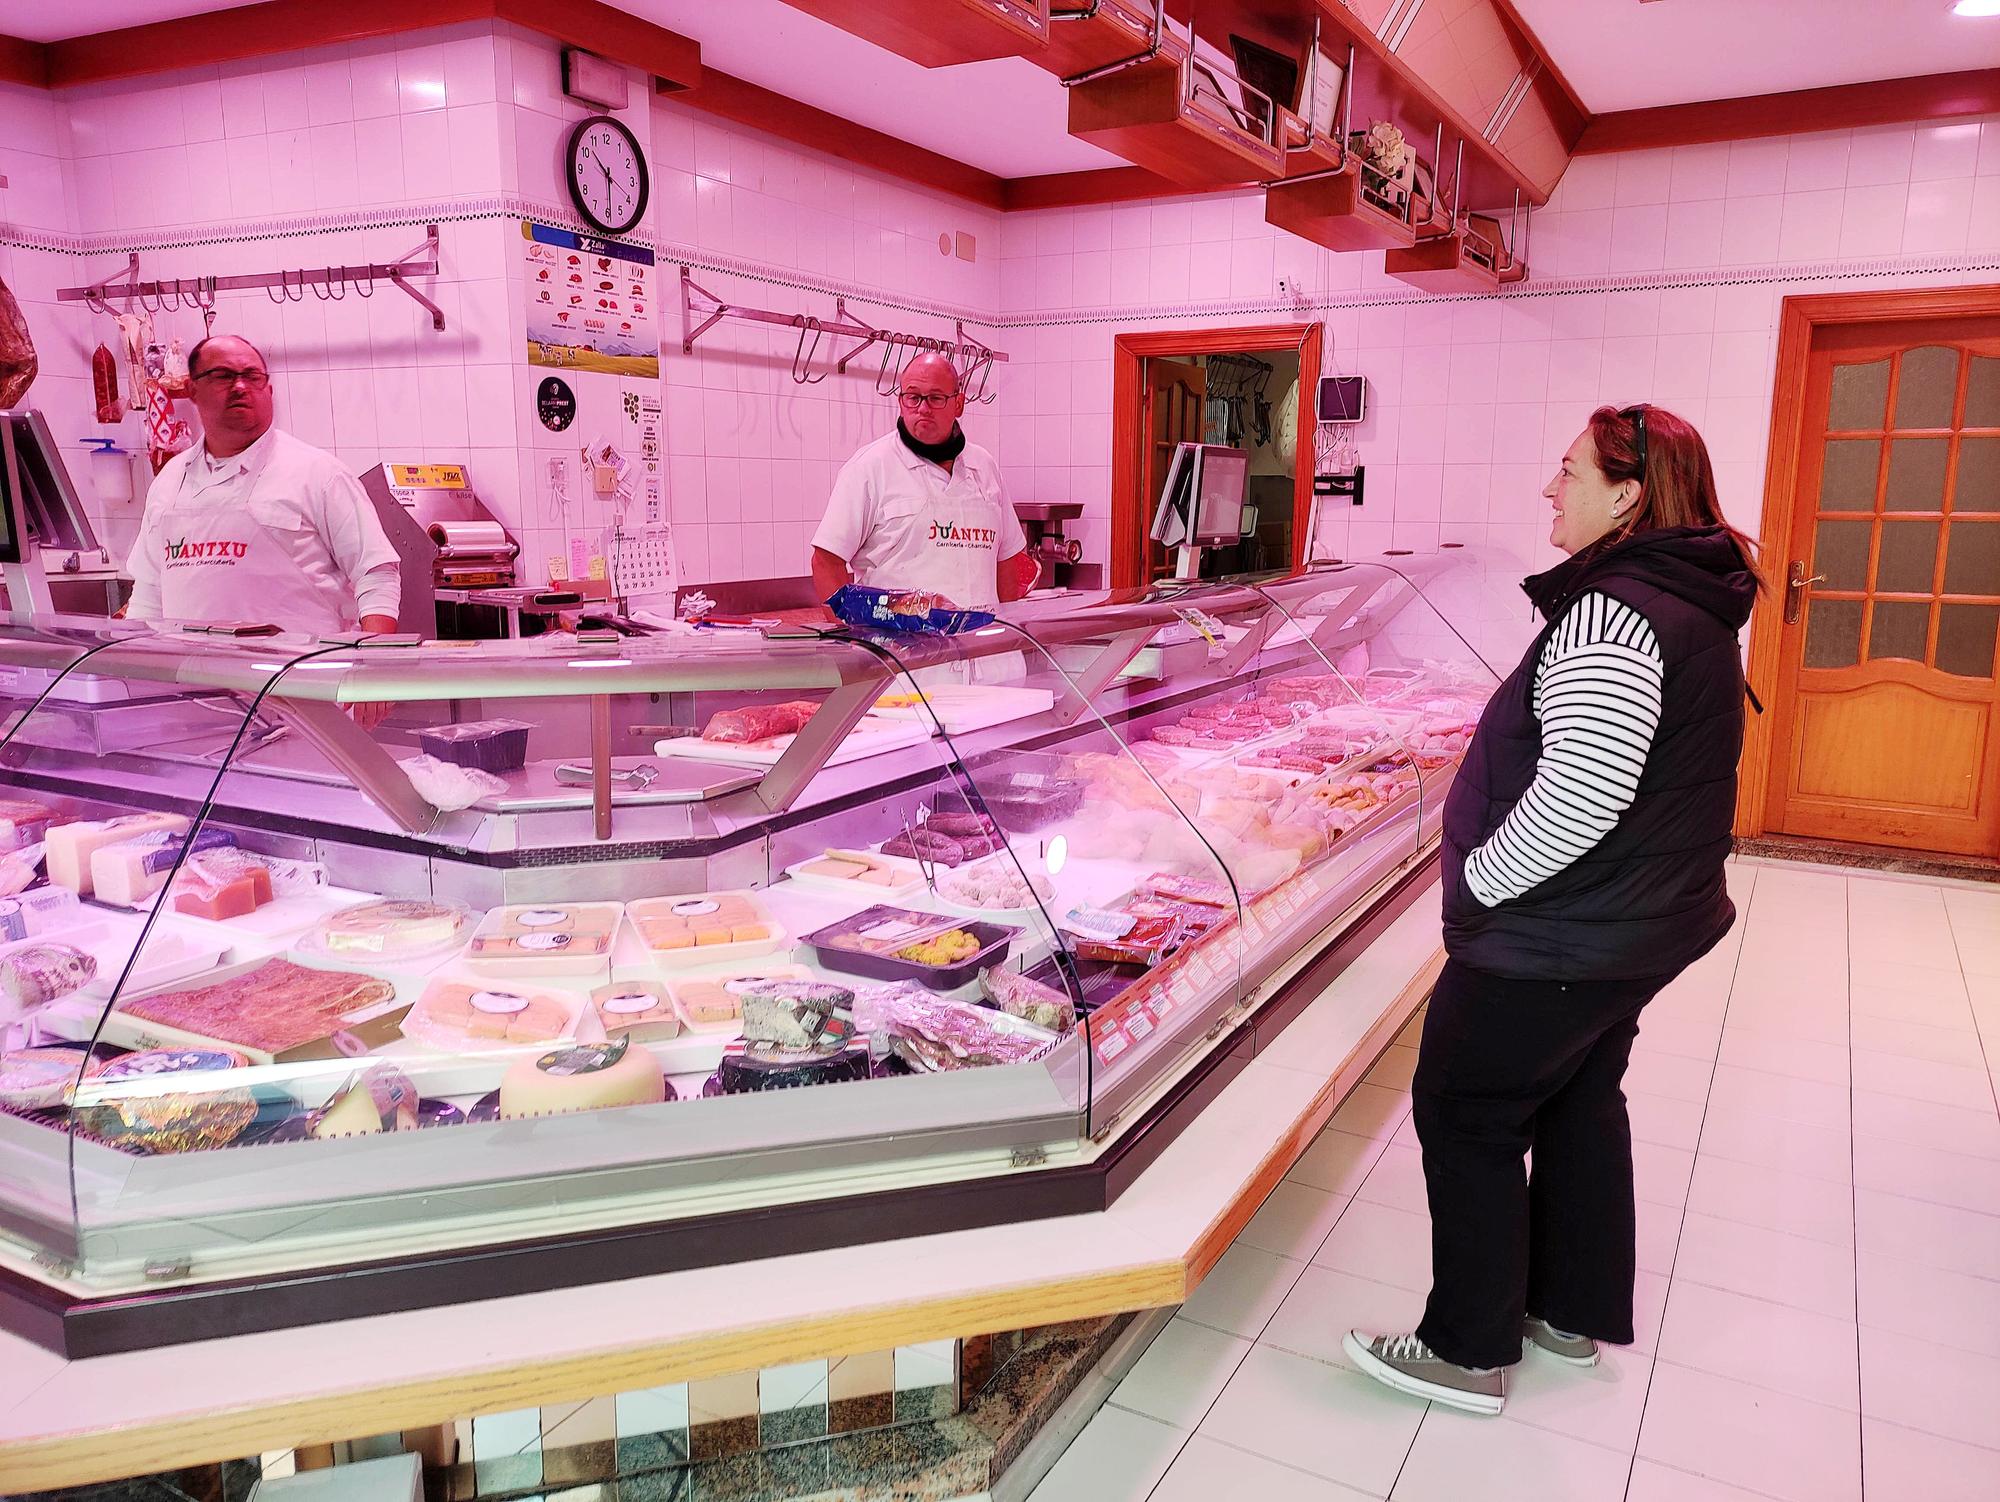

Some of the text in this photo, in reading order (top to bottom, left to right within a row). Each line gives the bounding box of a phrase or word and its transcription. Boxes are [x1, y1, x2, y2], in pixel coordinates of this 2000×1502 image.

[590, 135, 597, 147] 11
[602, 133, 611, 145] 12
[581, 147, 590, 158] 10
[617, 143, 621, 154] 1
[578, 164, 583, 174] 9
[625, 158, 631, 169] 2
[630, 177, 635, 188] 3
[582, 184, 588, 195] 8
[592, 199, 598, 210] 7
[625, 195, 631, 205] 4
[605, 207, 611, 218] 6
[617, 205, 623, 216] 5
[928, 519, 996, 544] JUANTXU
[164, 536, 248, 562] JUANTXU
